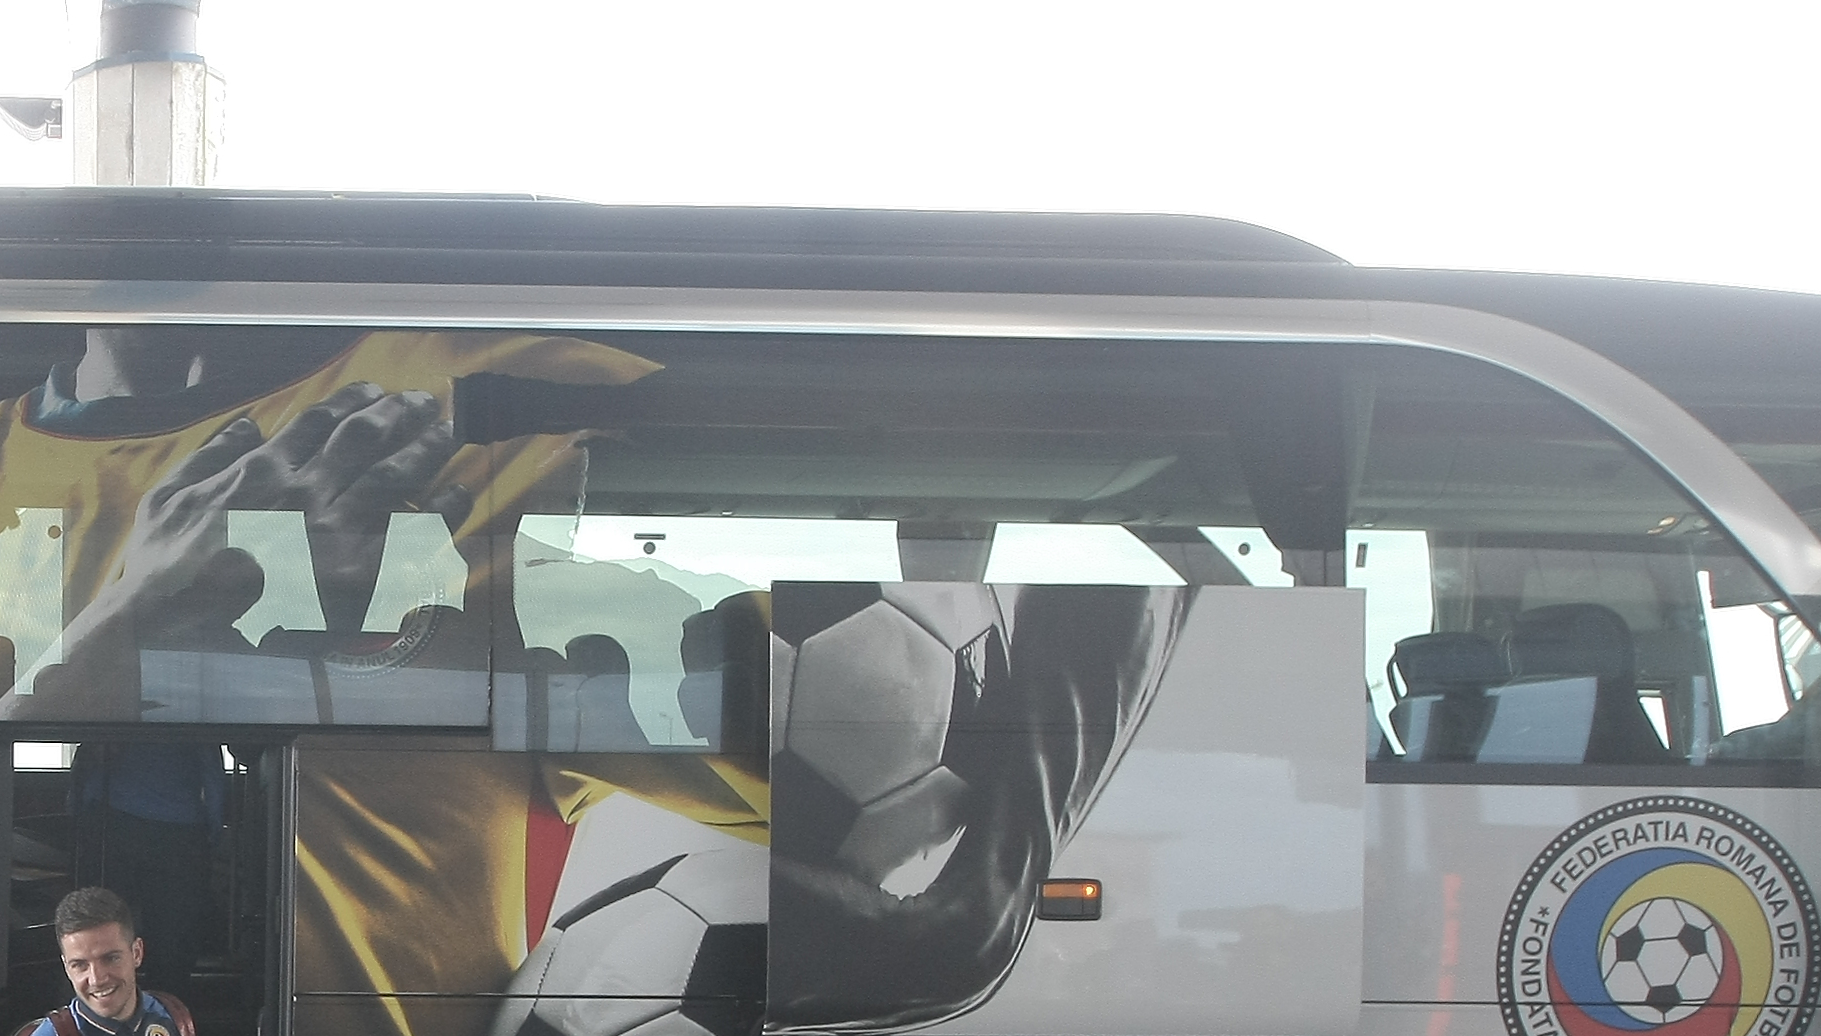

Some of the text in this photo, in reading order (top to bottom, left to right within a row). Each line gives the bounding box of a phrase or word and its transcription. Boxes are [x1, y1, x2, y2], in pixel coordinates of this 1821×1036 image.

[1550, 820, 1688, 893] FEDERATIA
[1694, 826, 1789, 917] ROMANA
[1777, 921, 1798, 960] DE
